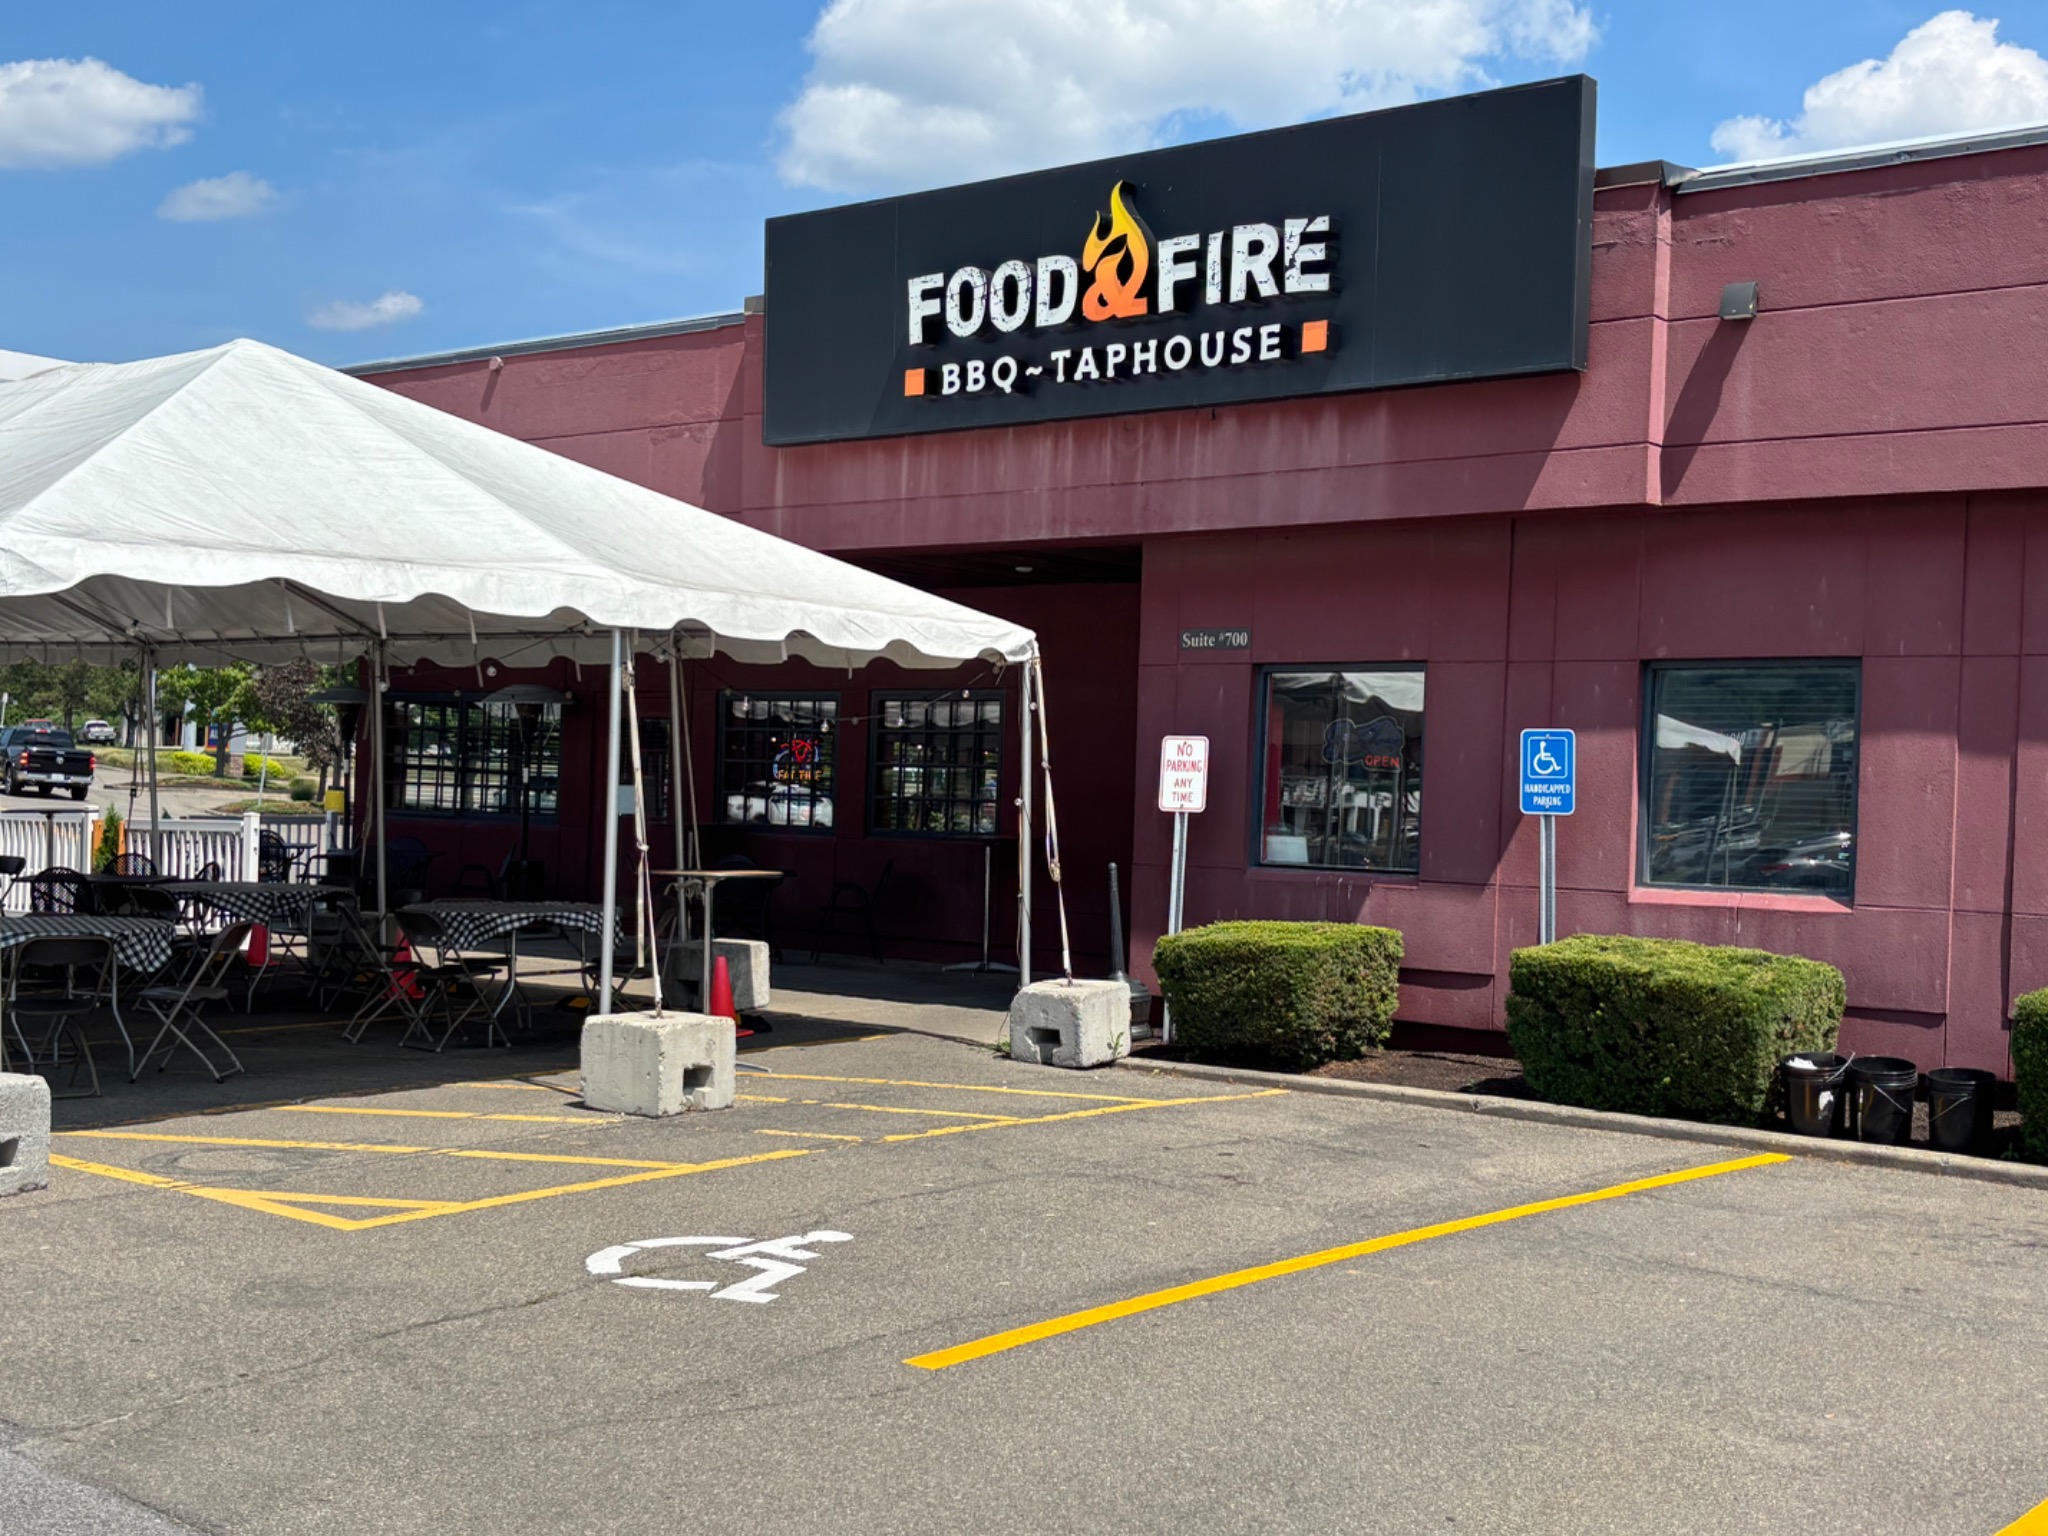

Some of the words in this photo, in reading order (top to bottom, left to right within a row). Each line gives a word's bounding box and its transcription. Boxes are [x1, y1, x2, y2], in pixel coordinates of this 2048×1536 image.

[907, 254, 1078, 346] FOOD
[1157, 215, 1330, 314] FIRE
[941, 355, 1018, 394] BBQ
[1050, 323, 1282, 383] TAPHOUSE
[1182, 631, 1216, 648] Suite
[1218, 631, 1249, 647] #700
[1176, 743, 1193, 757] NO
[1165, 759, 1203, 773] PARKING
[1364, 754, 1400, 768] OPEN
[1174, 778, 1193, 789] ANY
[1524, 784, 1570, 794] HANDICAPPED
[1172, 791, 1194, 803] TIME
[1533, 796, 1562, 805] PARKING
